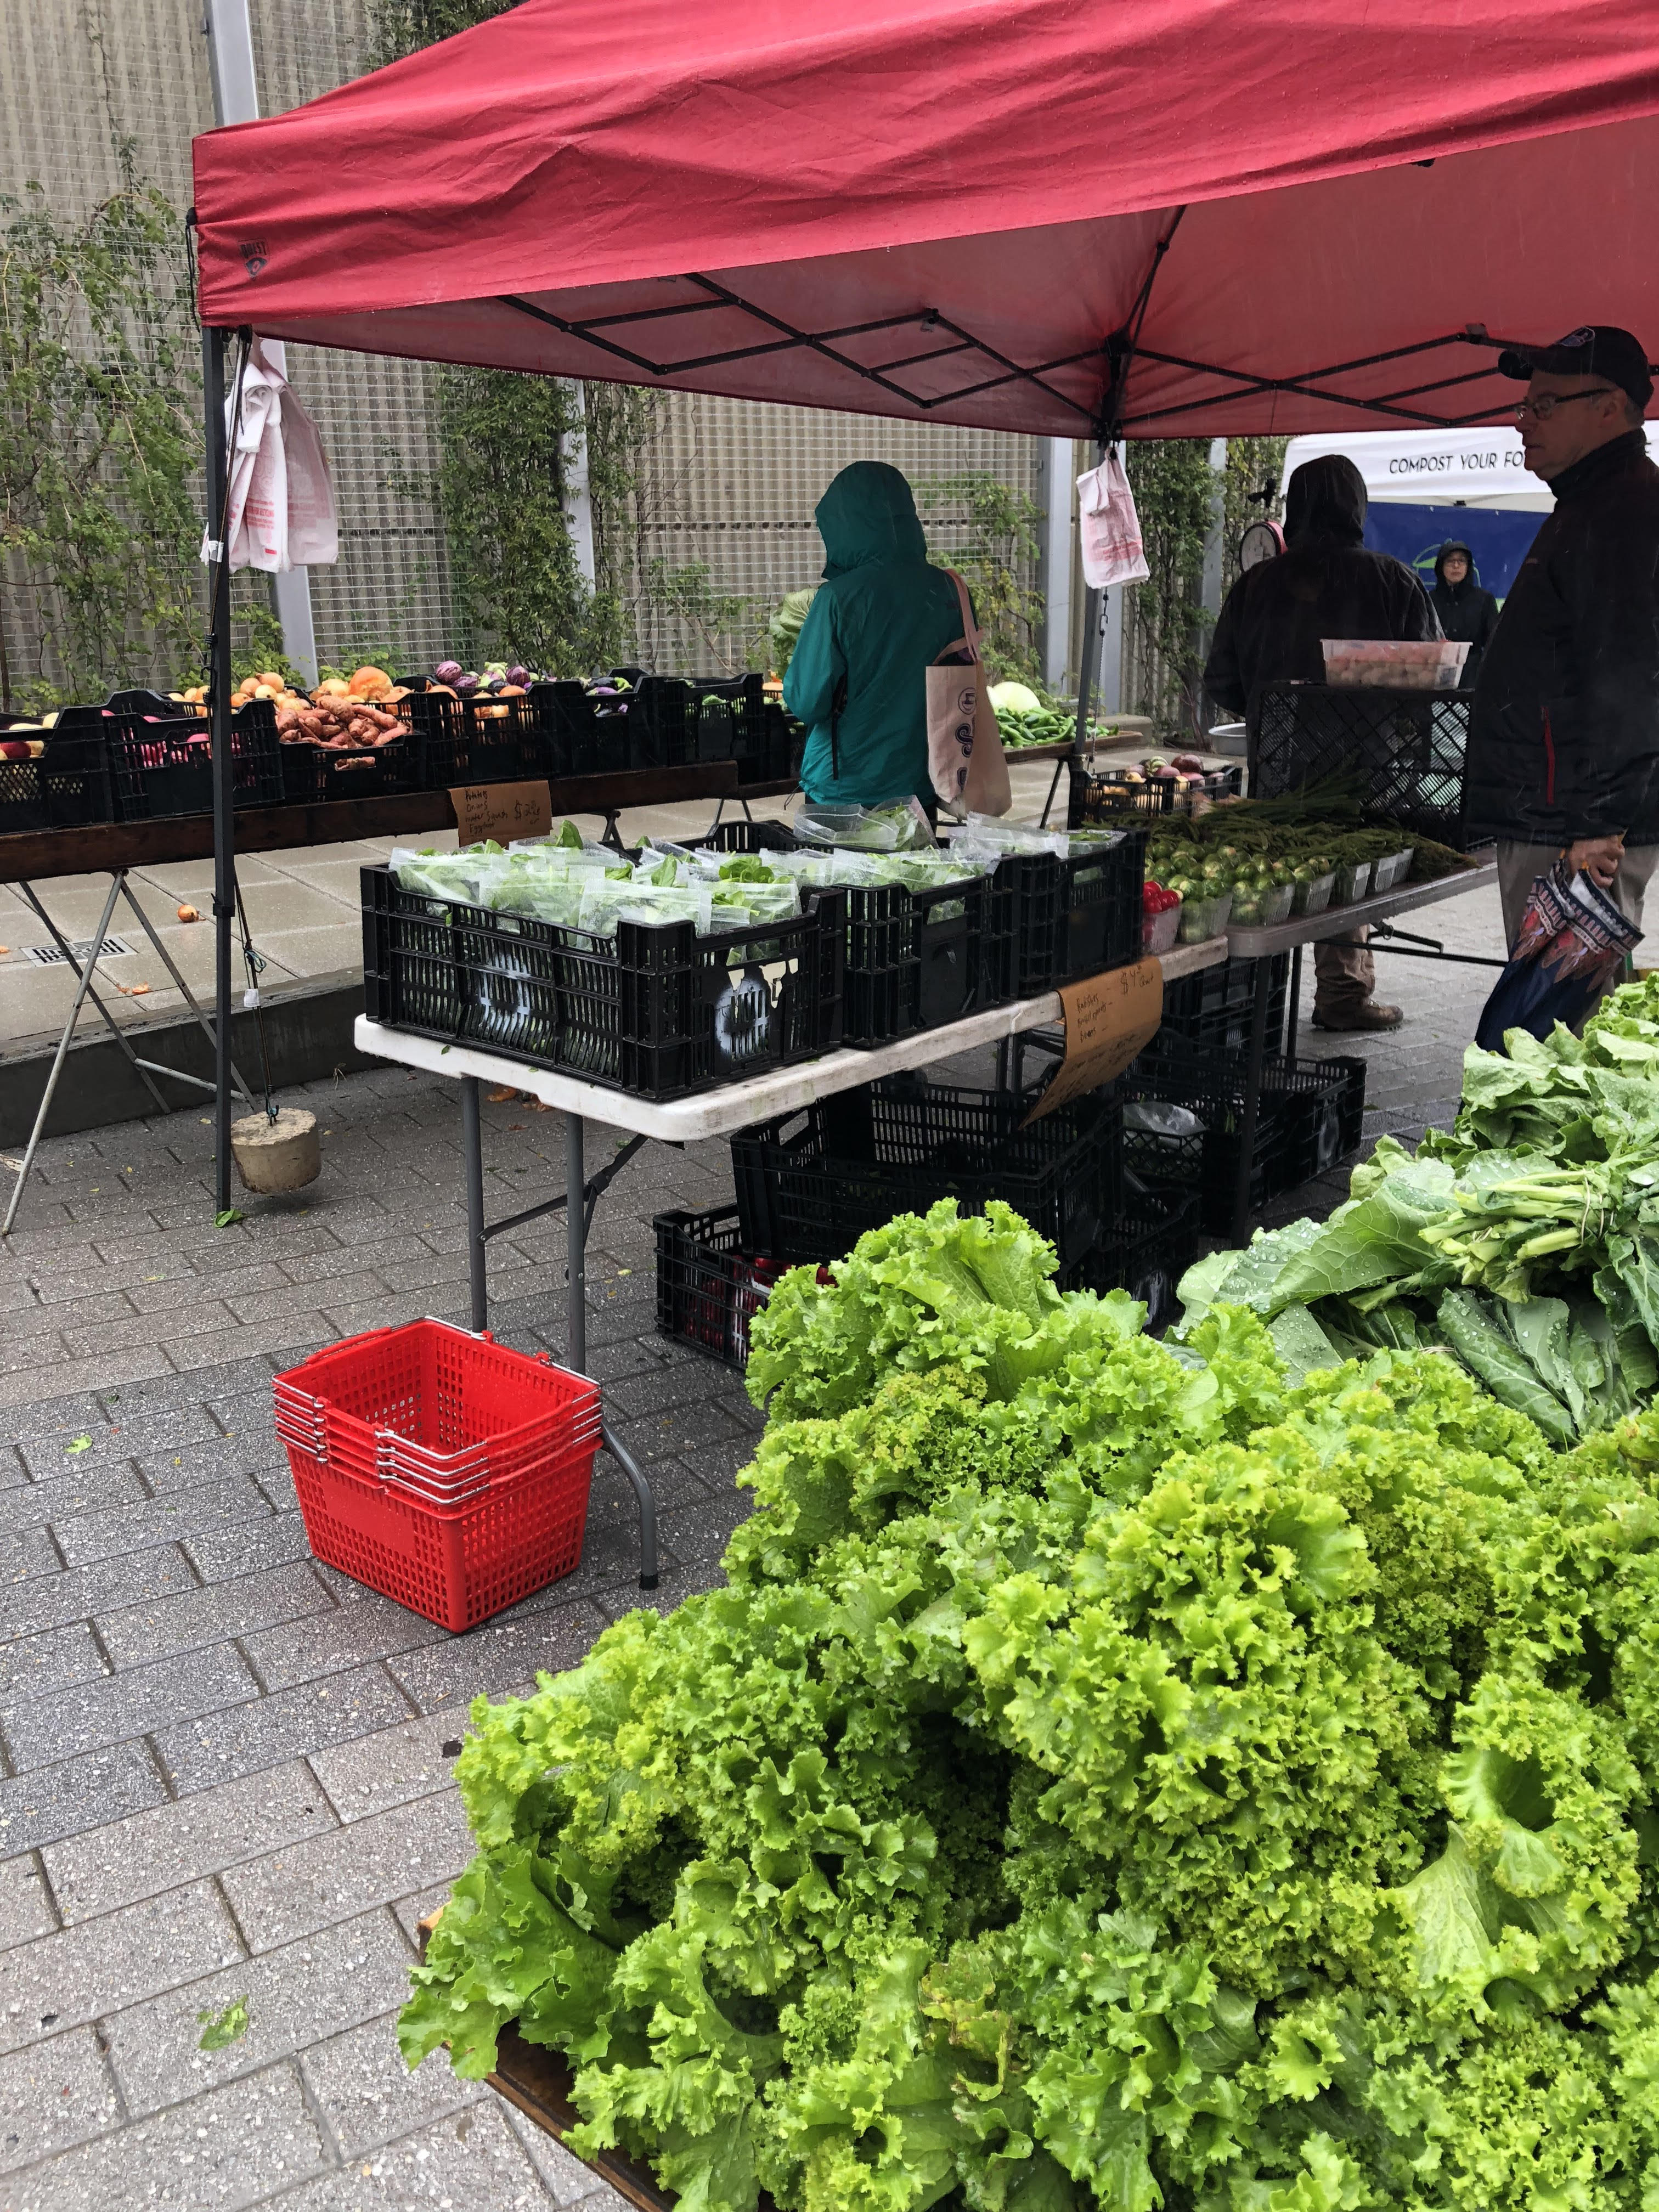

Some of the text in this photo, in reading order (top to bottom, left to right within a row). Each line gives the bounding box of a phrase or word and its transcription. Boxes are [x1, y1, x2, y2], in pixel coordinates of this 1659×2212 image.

[1390, 450, 1524, 474] COMPOST YOUR FO
